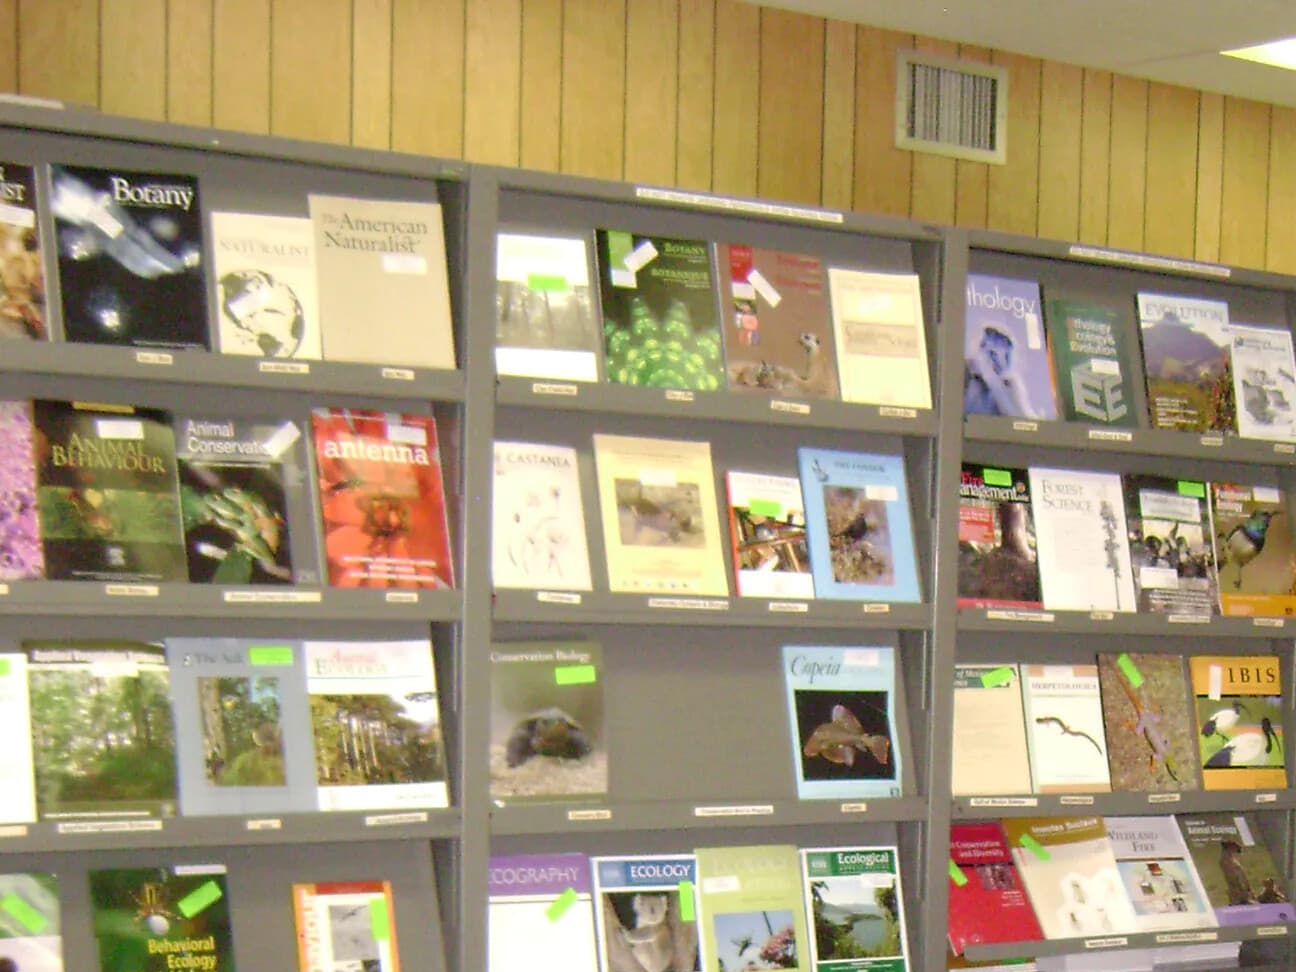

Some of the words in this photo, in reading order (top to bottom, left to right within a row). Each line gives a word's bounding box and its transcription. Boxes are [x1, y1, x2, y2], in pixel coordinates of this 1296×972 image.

[112, 177, 194, 211] Botany
[339, 212, 429, 235] American
[324, 230, 422, 254] Naturalist
[967, 283, 1037, 320] thology
[188, 420, 235, 438] Animal
[70, 432, 146, 456] ANIMAL
[324, 440, 429, 465] antenna
[53, 445, 166, 473] BEHAVIOUR
[506, 452, 572, 470] CASTANEA
[959, 484, 1018, 501] anagement
[490, 651, 555, 664] Conservation
[556, 649, 593, 665] Biology
[790, 655, 842, 685] Copeia
[1228, 667, 1275, 683] IBIS
[837, 851, 891, 868] Ecological
[630, 864, 693, 880] ECOLOGY
[148, 937, 215, 955] Behavioral
[167, 954, 218, 972] Ecology
